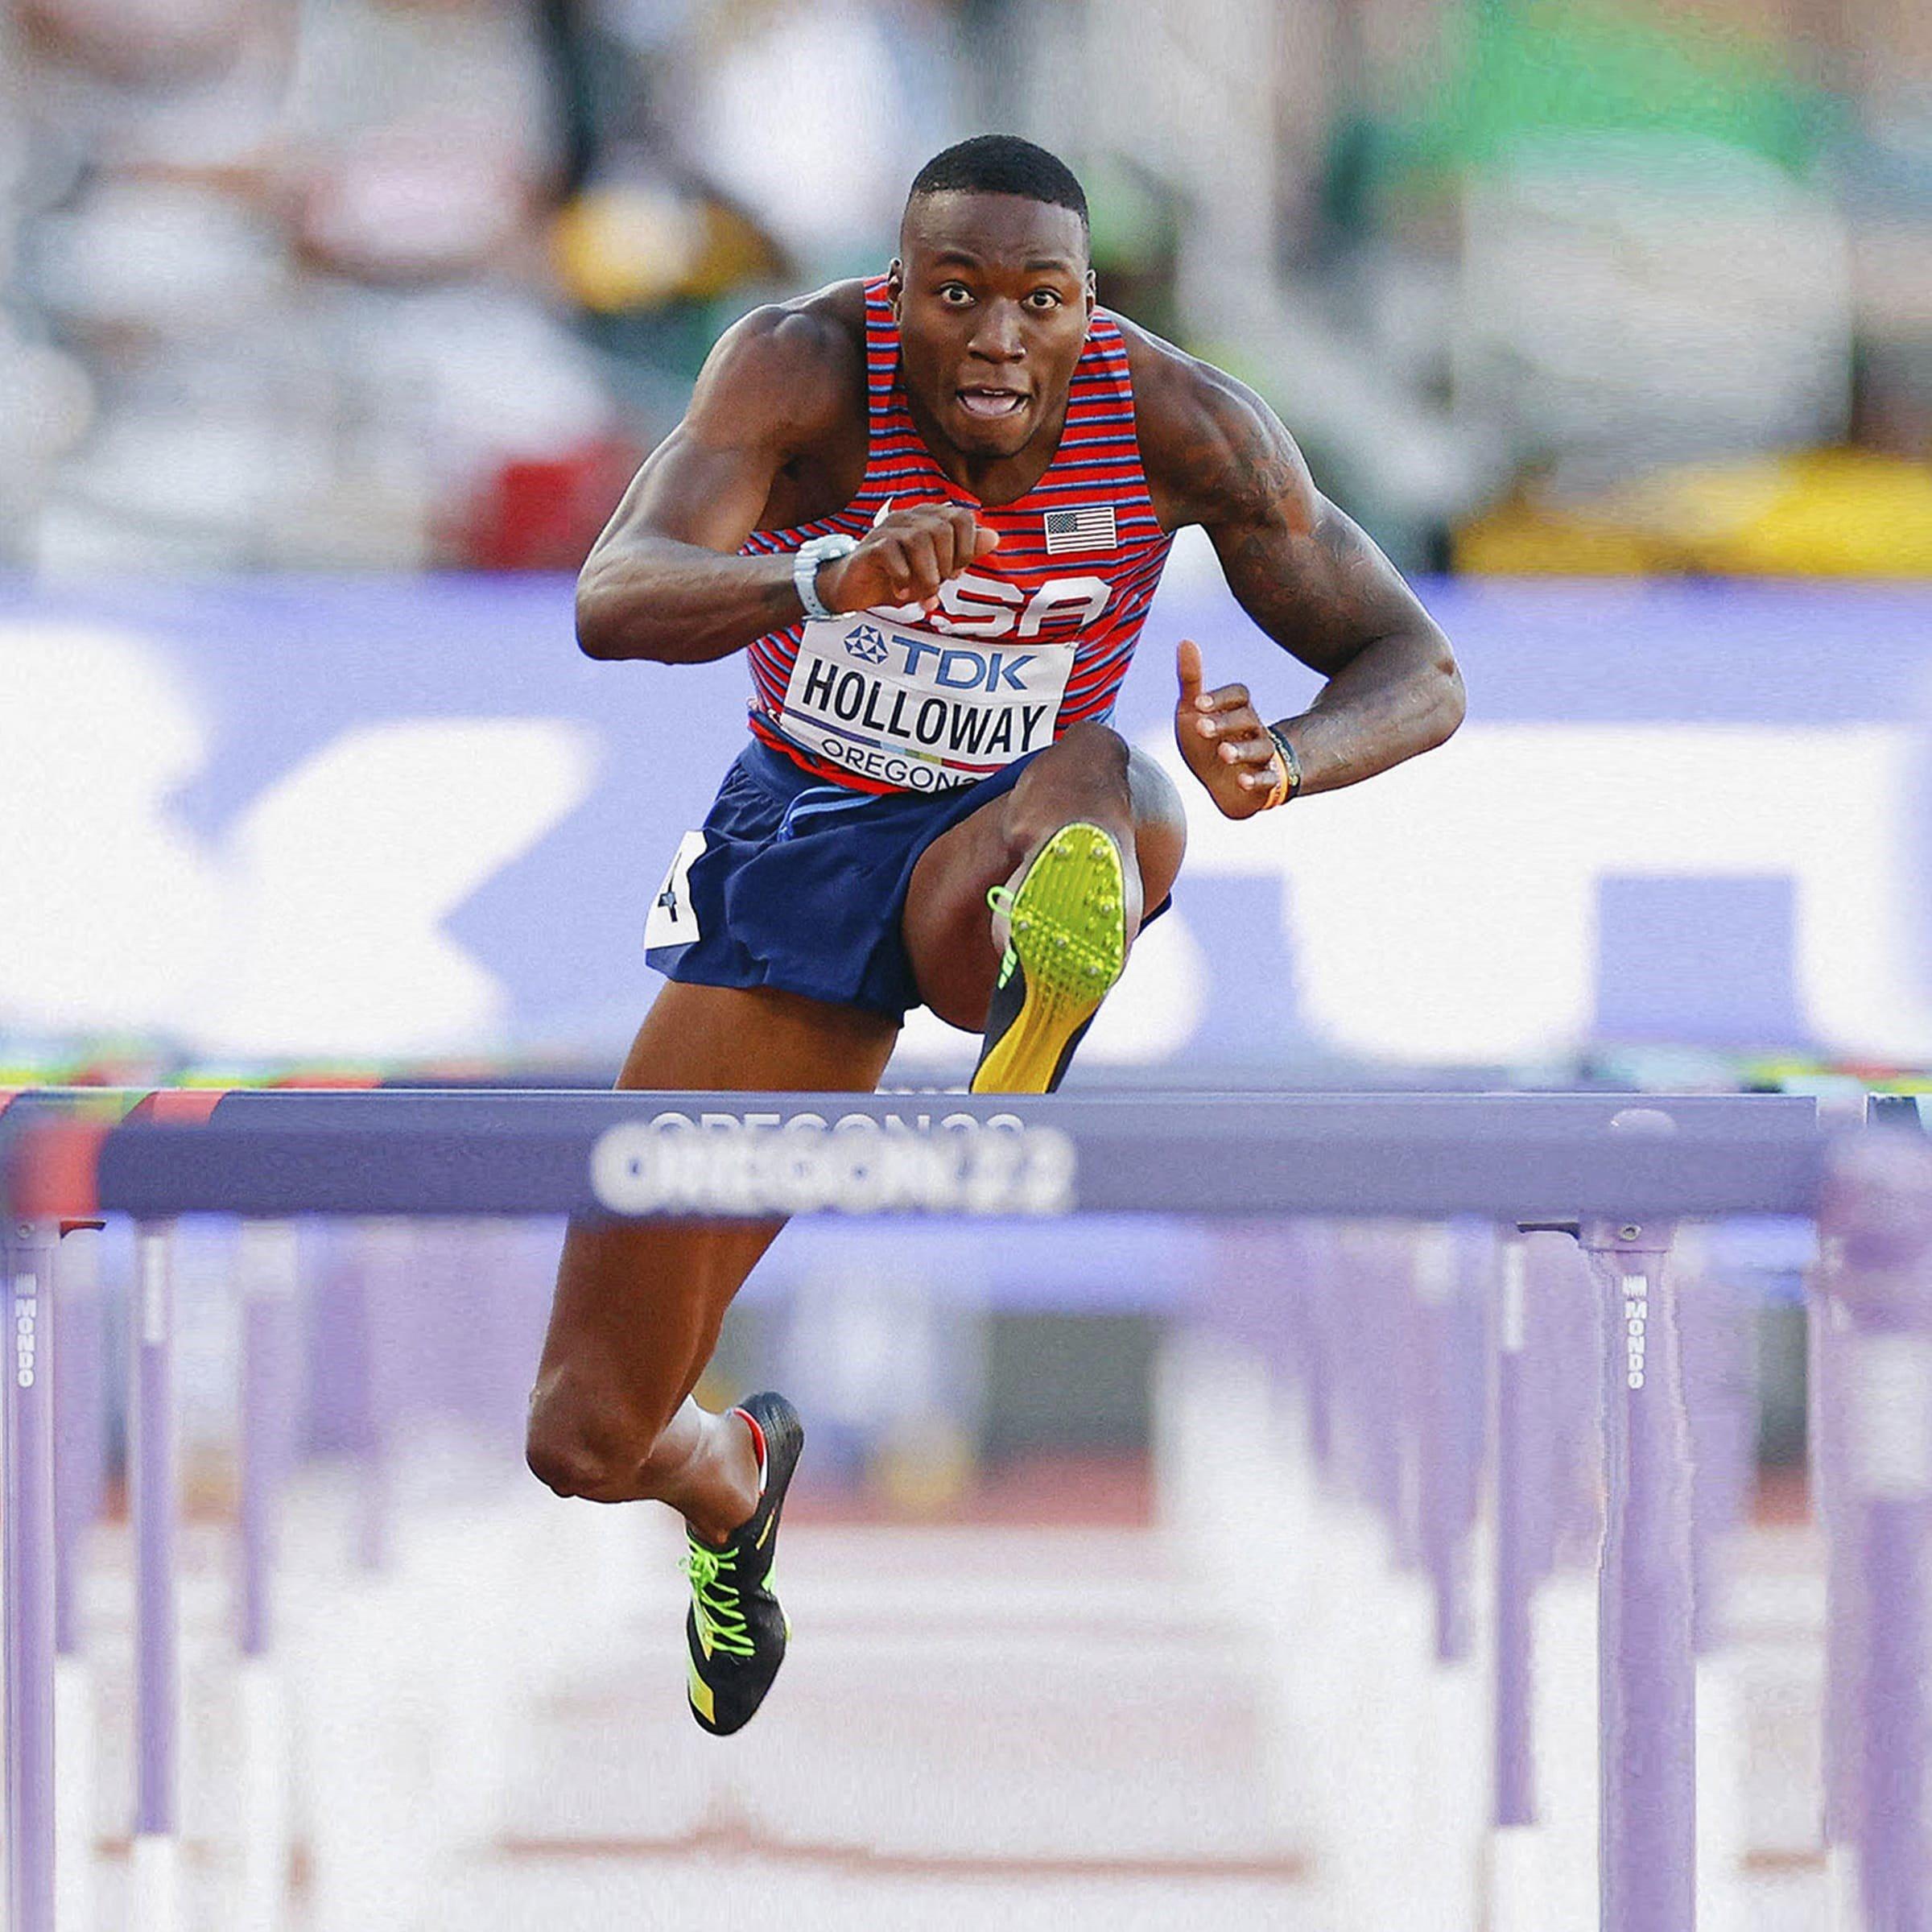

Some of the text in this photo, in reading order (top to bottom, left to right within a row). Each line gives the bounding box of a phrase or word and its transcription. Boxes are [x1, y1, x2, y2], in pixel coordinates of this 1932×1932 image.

[802, 658, 1048, 755] HOLLOWAY
[892, 634, 1038, 693] TDK
[14, 1298, 36, 1388] MONDO
[1624, 1299, 1647, 1389] MONDO
